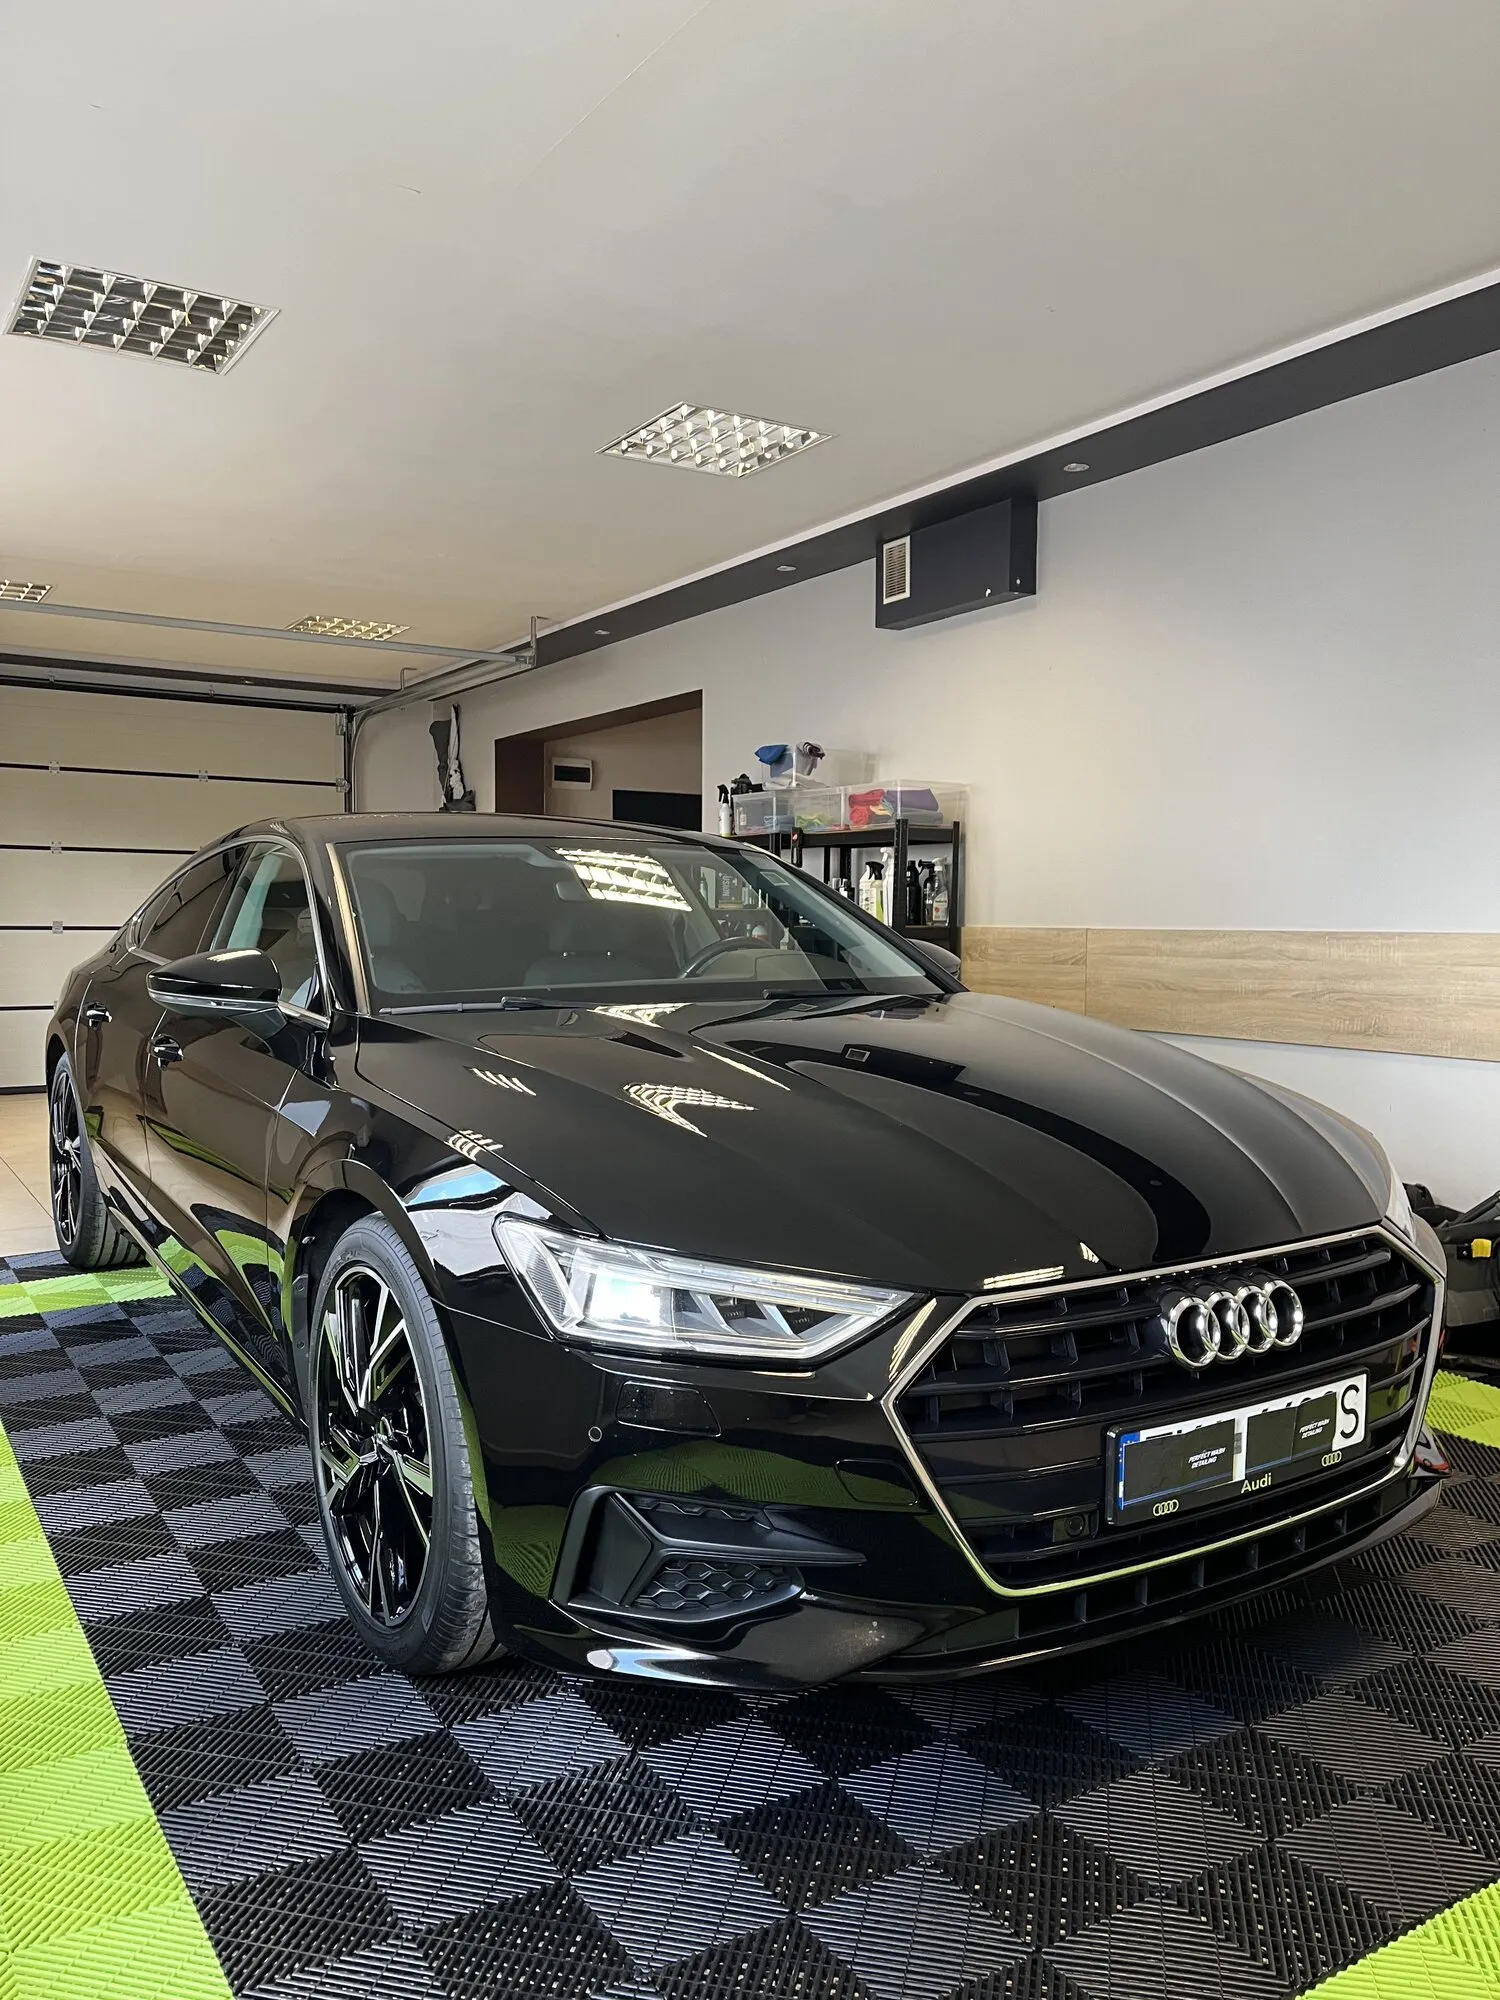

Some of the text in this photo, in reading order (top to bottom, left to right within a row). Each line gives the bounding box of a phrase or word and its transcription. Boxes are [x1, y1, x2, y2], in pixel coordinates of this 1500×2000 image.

[1188, 1452, 1211, 1463] PERFECT
[1191, 1456, 1217, 1469] DETAILING
[1241, 1472, 1272, 1494] Audi
